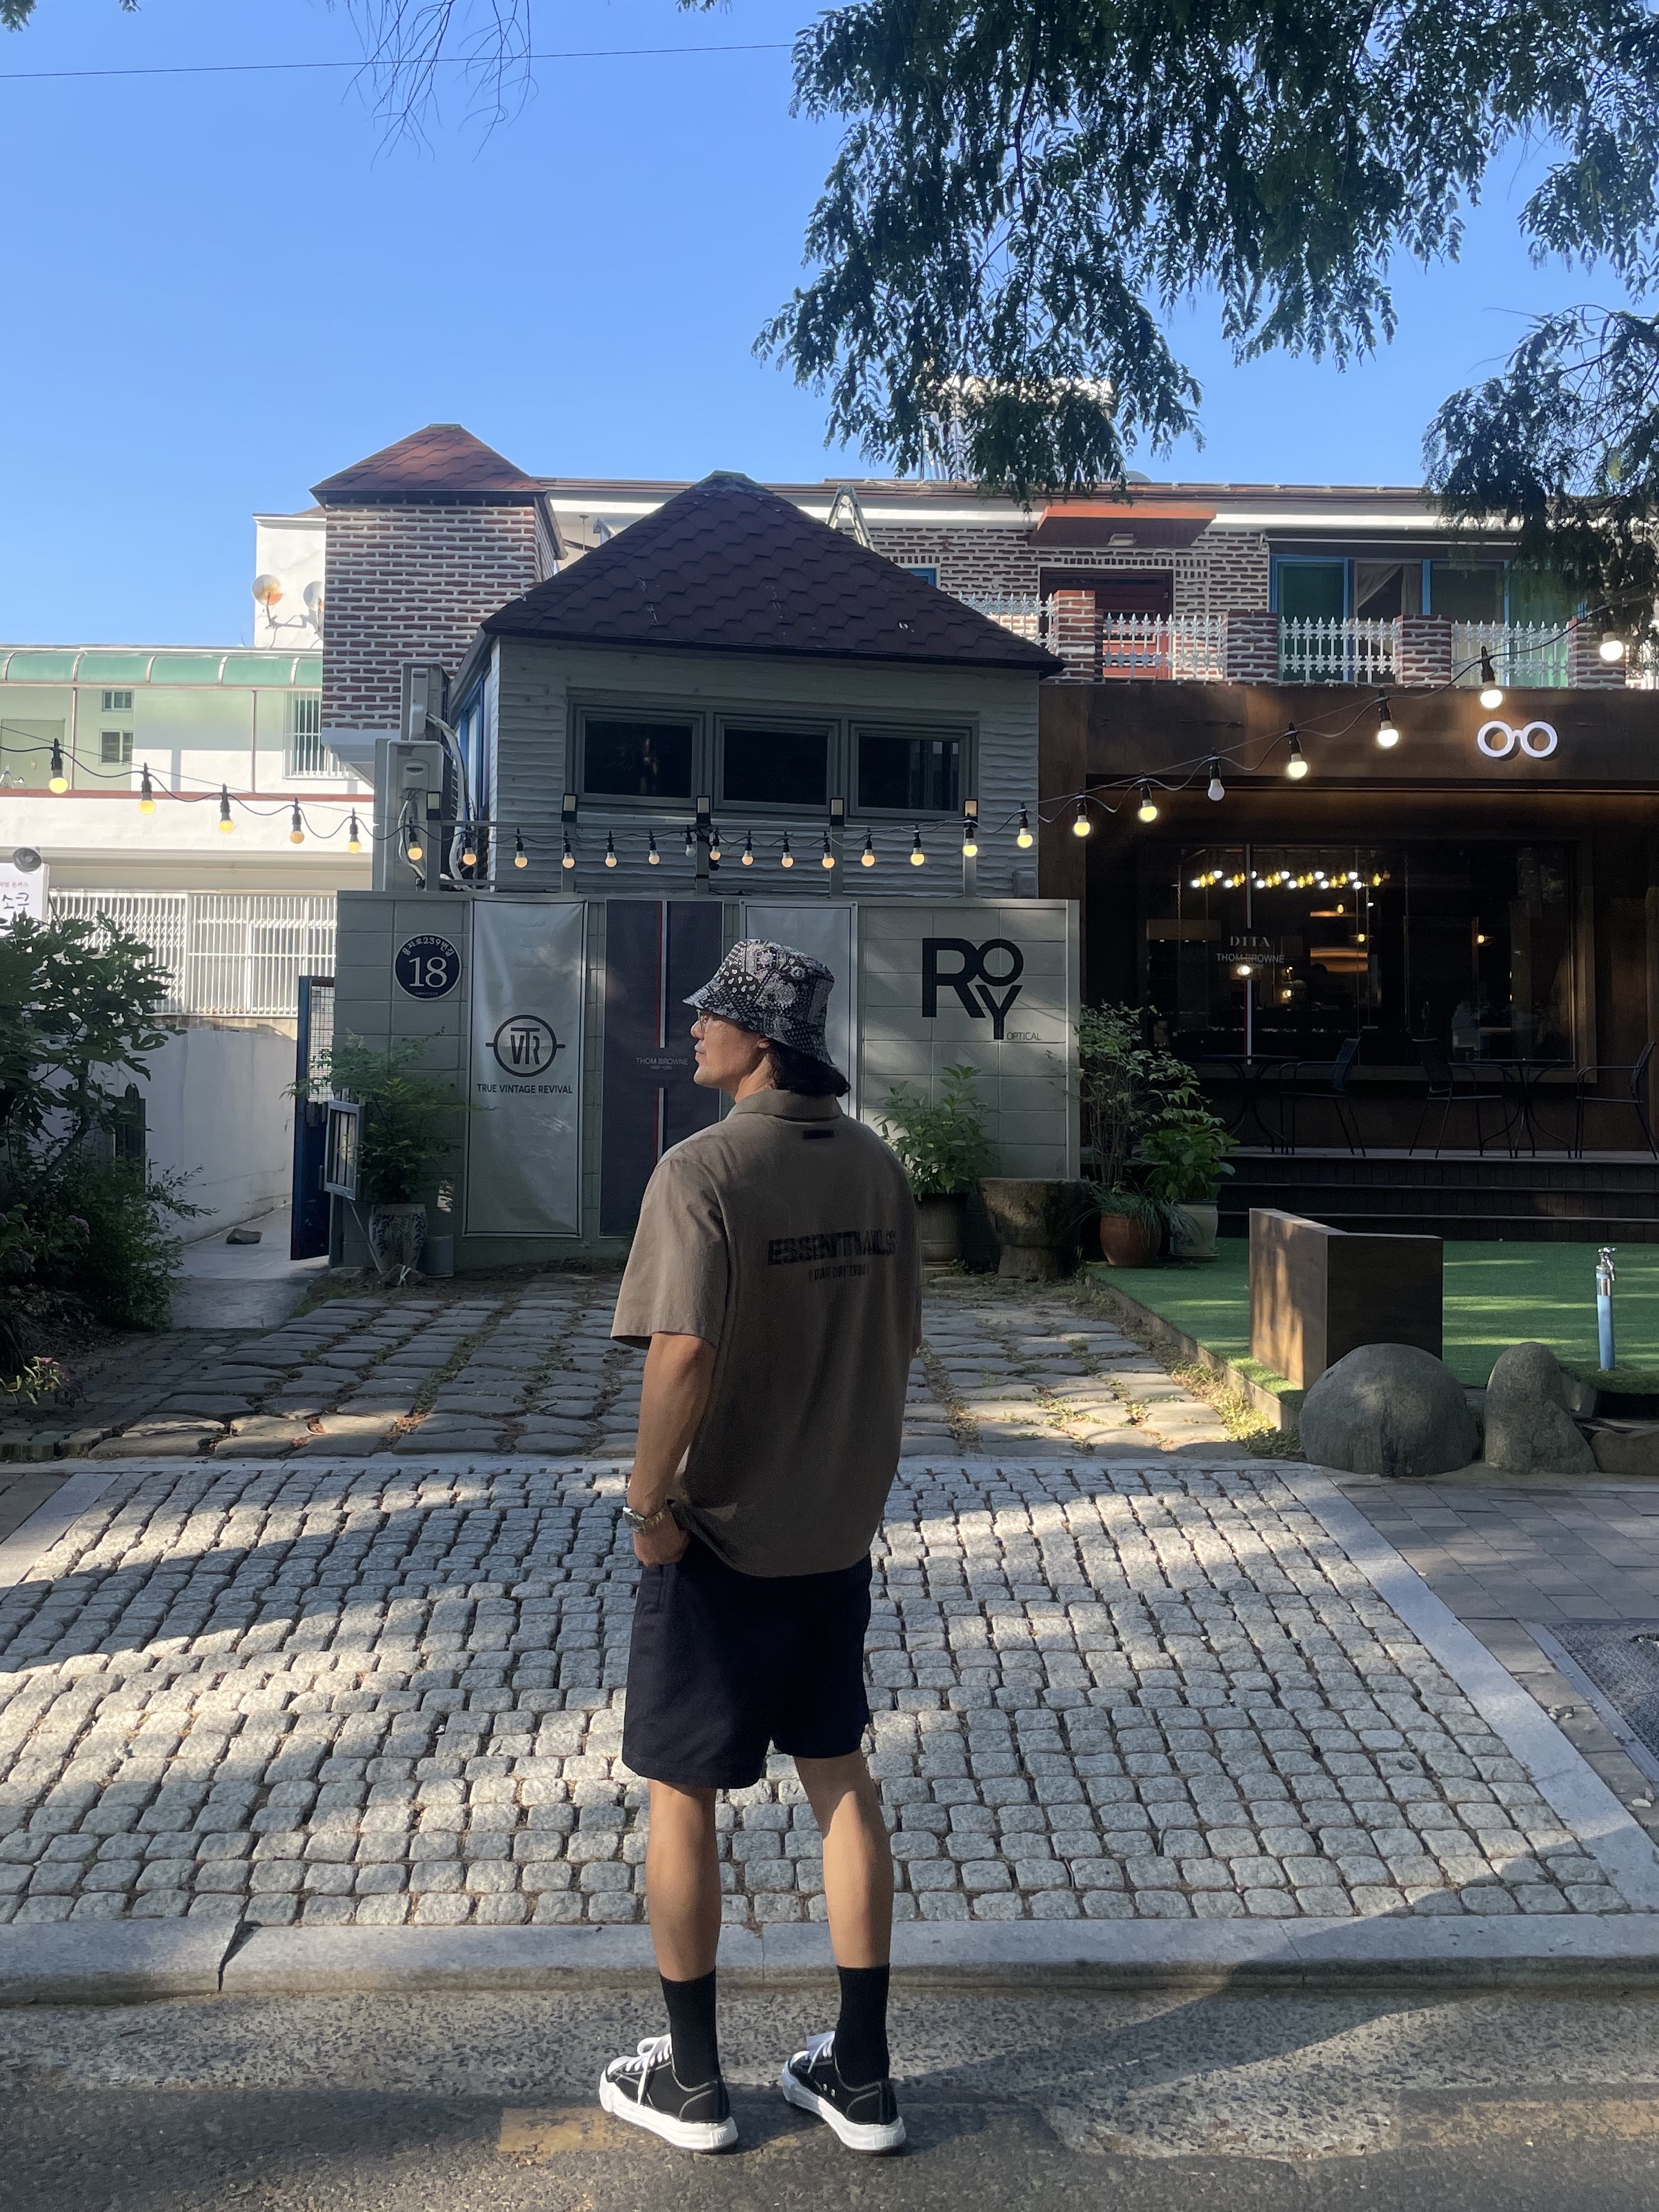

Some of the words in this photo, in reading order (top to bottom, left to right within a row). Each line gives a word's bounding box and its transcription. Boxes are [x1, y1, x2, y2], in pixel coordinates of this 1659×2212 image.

[1230, 936, 1271, 947] DITA
[1216, 953, 1242, 962] THOM
[1245, 954, 1284, 964] BROWNE
[409, 957, 447, 988] 18
[922, 938, 1024, 1039] ROY
[1006, 1032, 1042, 1041] OPTICAL
[477, 1084, 497, 1093] TRUE
[499, 1084, 536, 1094] VINTAGE
[539, 1085, 573, 1094] REVIVAL
